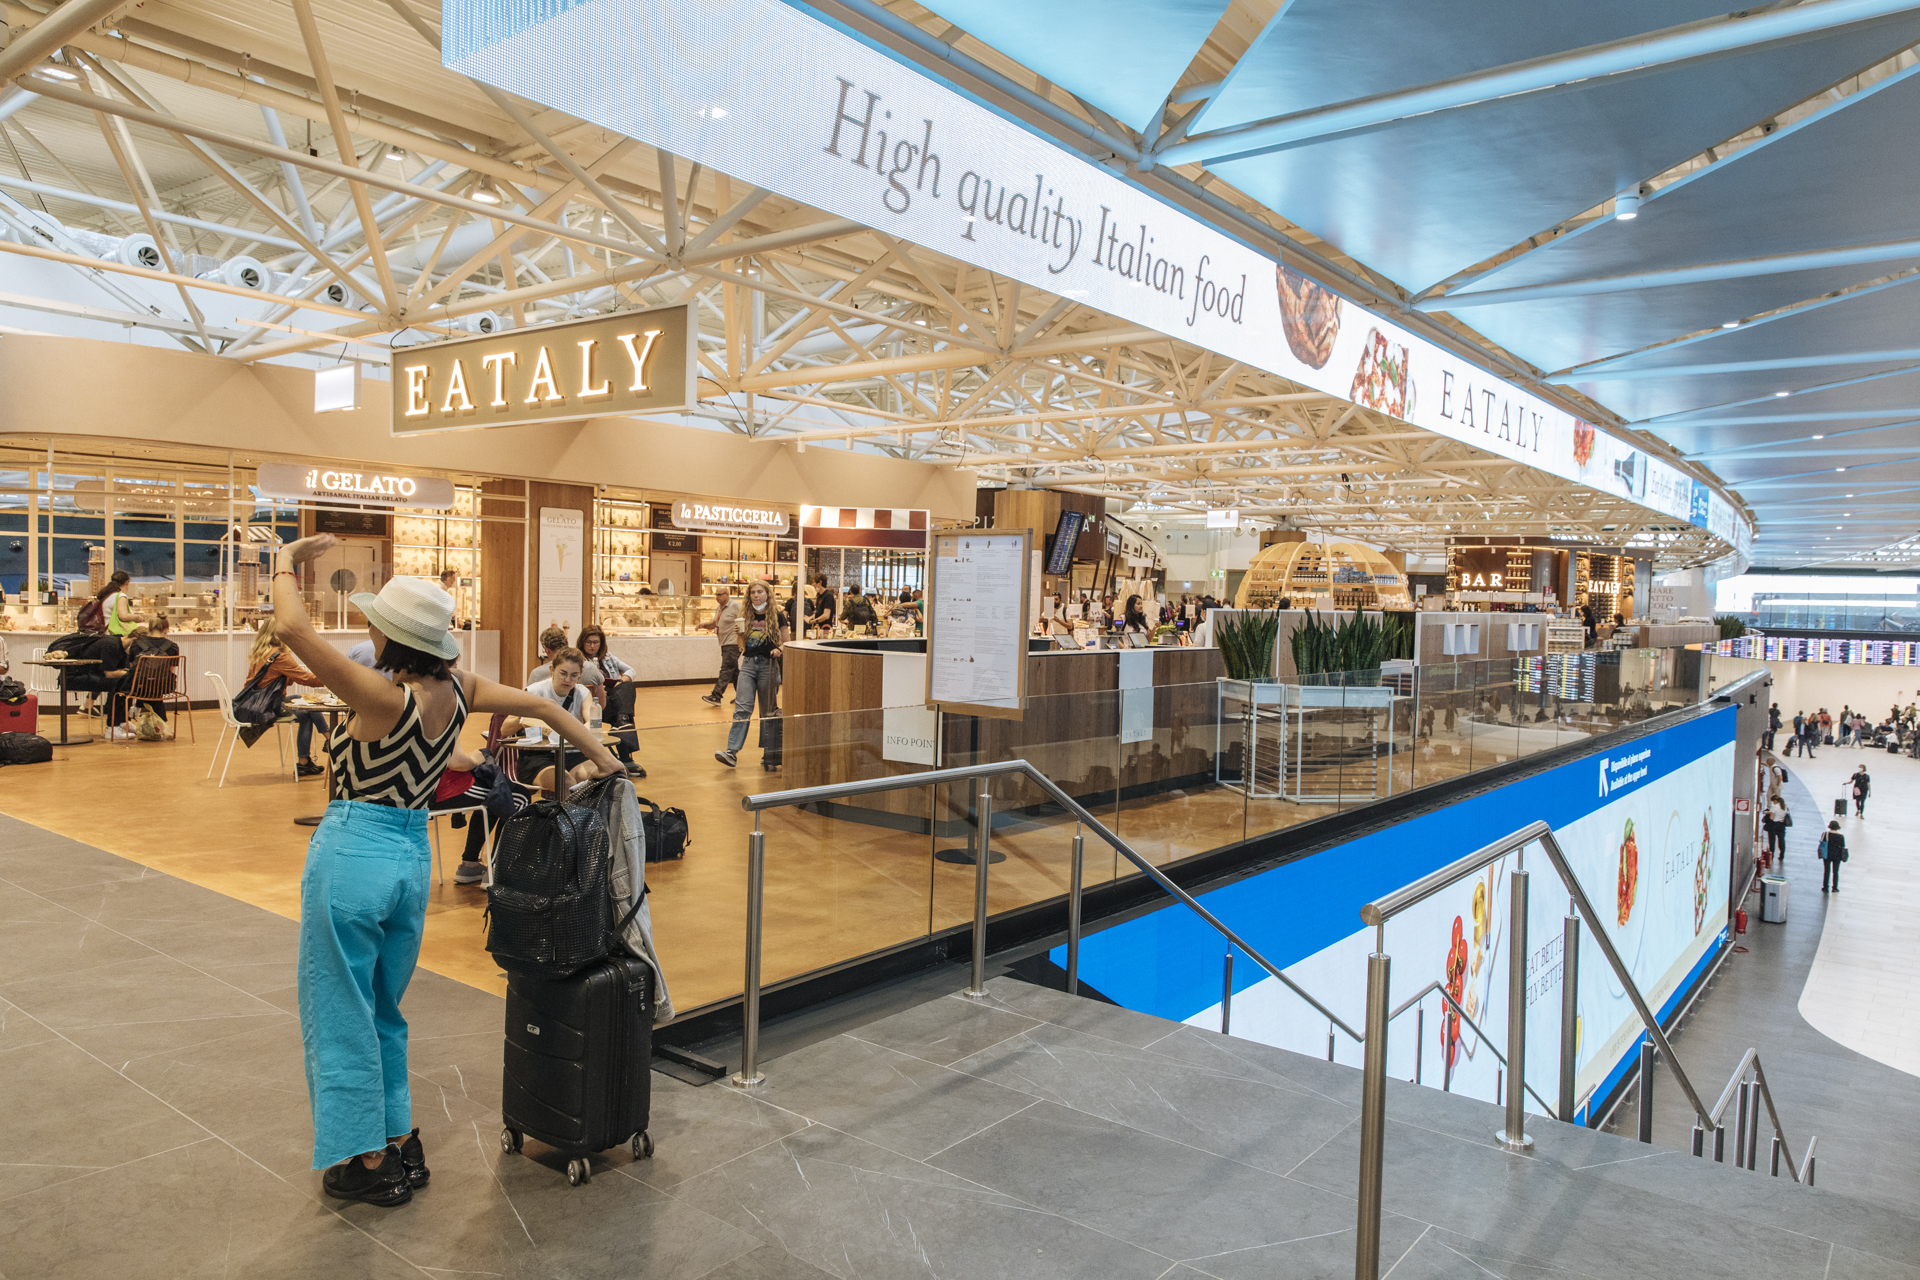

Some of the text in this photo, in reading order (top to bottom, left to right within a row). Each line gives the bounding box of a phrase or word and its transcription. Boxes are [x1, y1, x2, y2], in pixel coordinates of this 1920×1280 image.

[824, 75, 1247, 327] High quality Italian food
[404, 329, 665, 417] EATALY
[1440, 369, 1544, 453] EATALY
[305, 469, 417, 497] il GELATO
[312, 491, 352, 499] ARTISANAL
[353, 493, 380, 501] ITALIAN
[546, 516, 577, 526] GELATO
[680, 503, 692, 519] la
[693, 504, 784, 526] PASTICCERIA
[1461, 573, 1503, 587] BAR
[1588, 580, 1621, 595] EATALY
[887, 735, 935, 749] INFO POIN
[1665, 841, 1696, 884] EATALY
[1526, 932, 1563, 979] EAT BETTE
[1526, 960, 1563, 1009] FLY BETTE
